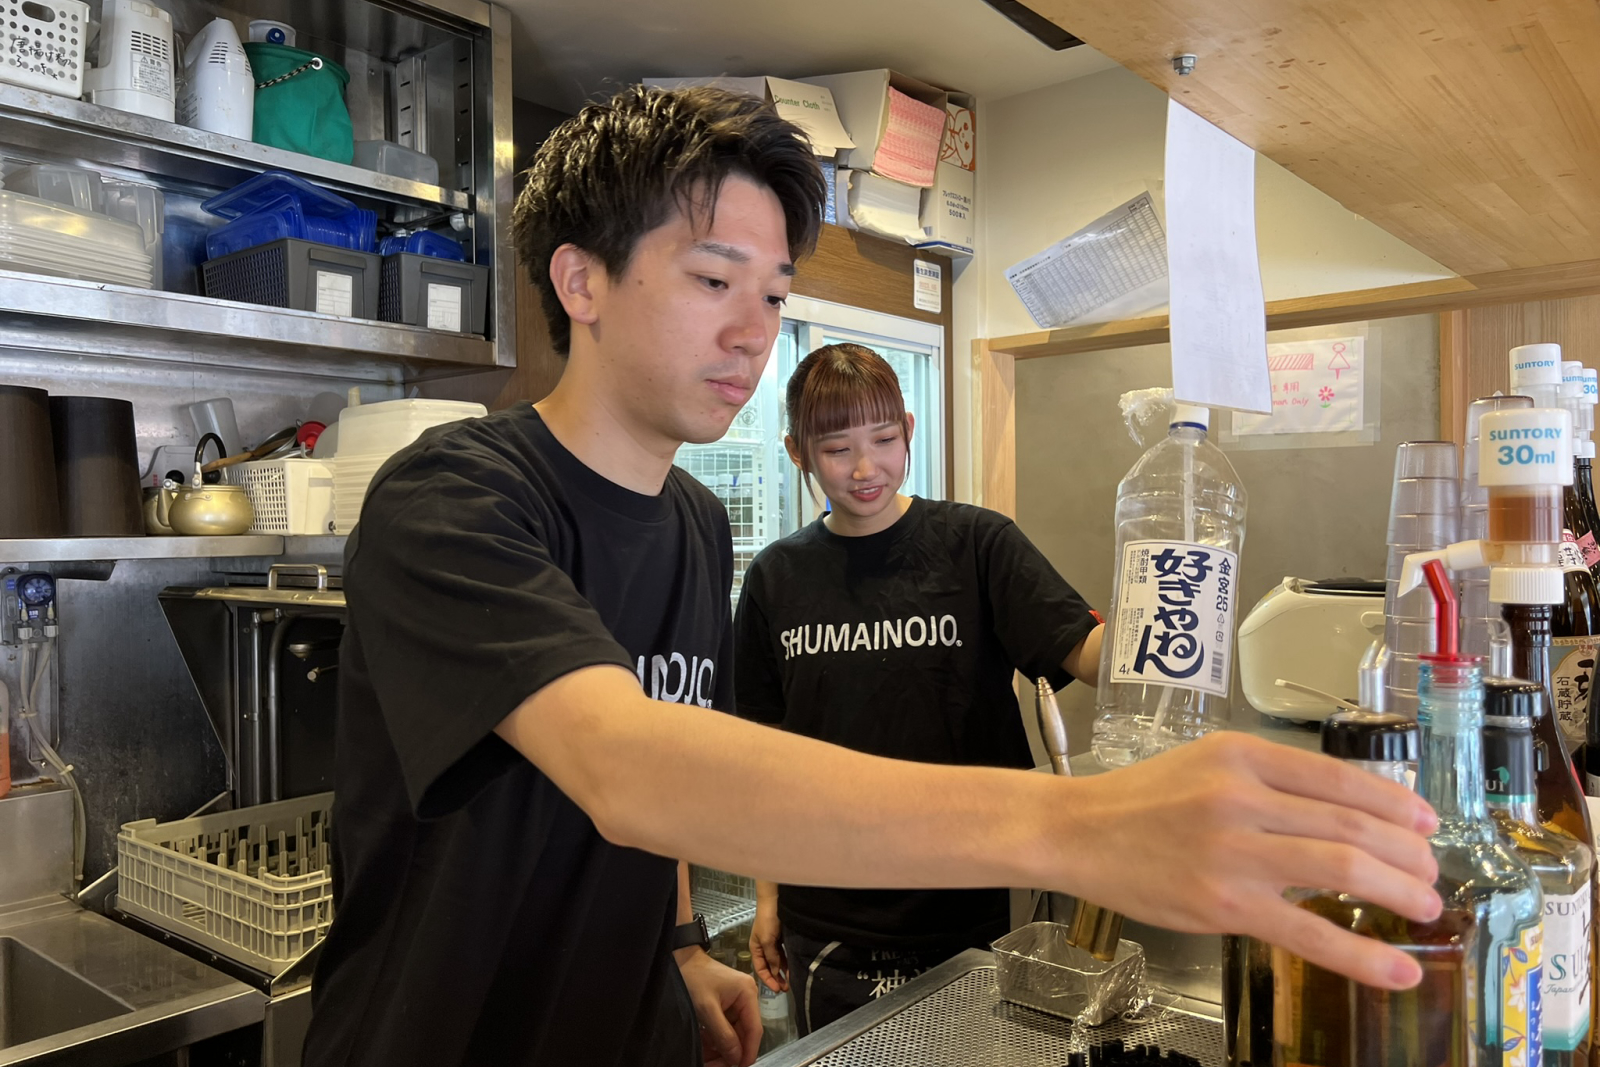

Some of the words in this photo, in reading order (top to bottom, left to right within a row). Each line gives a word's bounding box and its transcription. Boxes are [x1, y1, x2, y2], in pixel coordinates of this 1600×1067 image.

[774, 94, 800, 107] Counter
[802, 99, 820, 110] Cloth
[1514, 360, 1555, 370] SUNTORY
[1583, 384, 1598, 394] 30
[1291, 397, 1309, 408] Only
[1489, 427, 1563, 441] SUNTORY
[1497, 445, 1555, 465] 30ml
[1138, 548, 1150, 584] 焼酎甲類
[1133, 548, 1213, 679] 好きやねん
[1556, 676, 1573, 721] 石蔵貯蔵
[1485, 779, 1505, 792] UI
